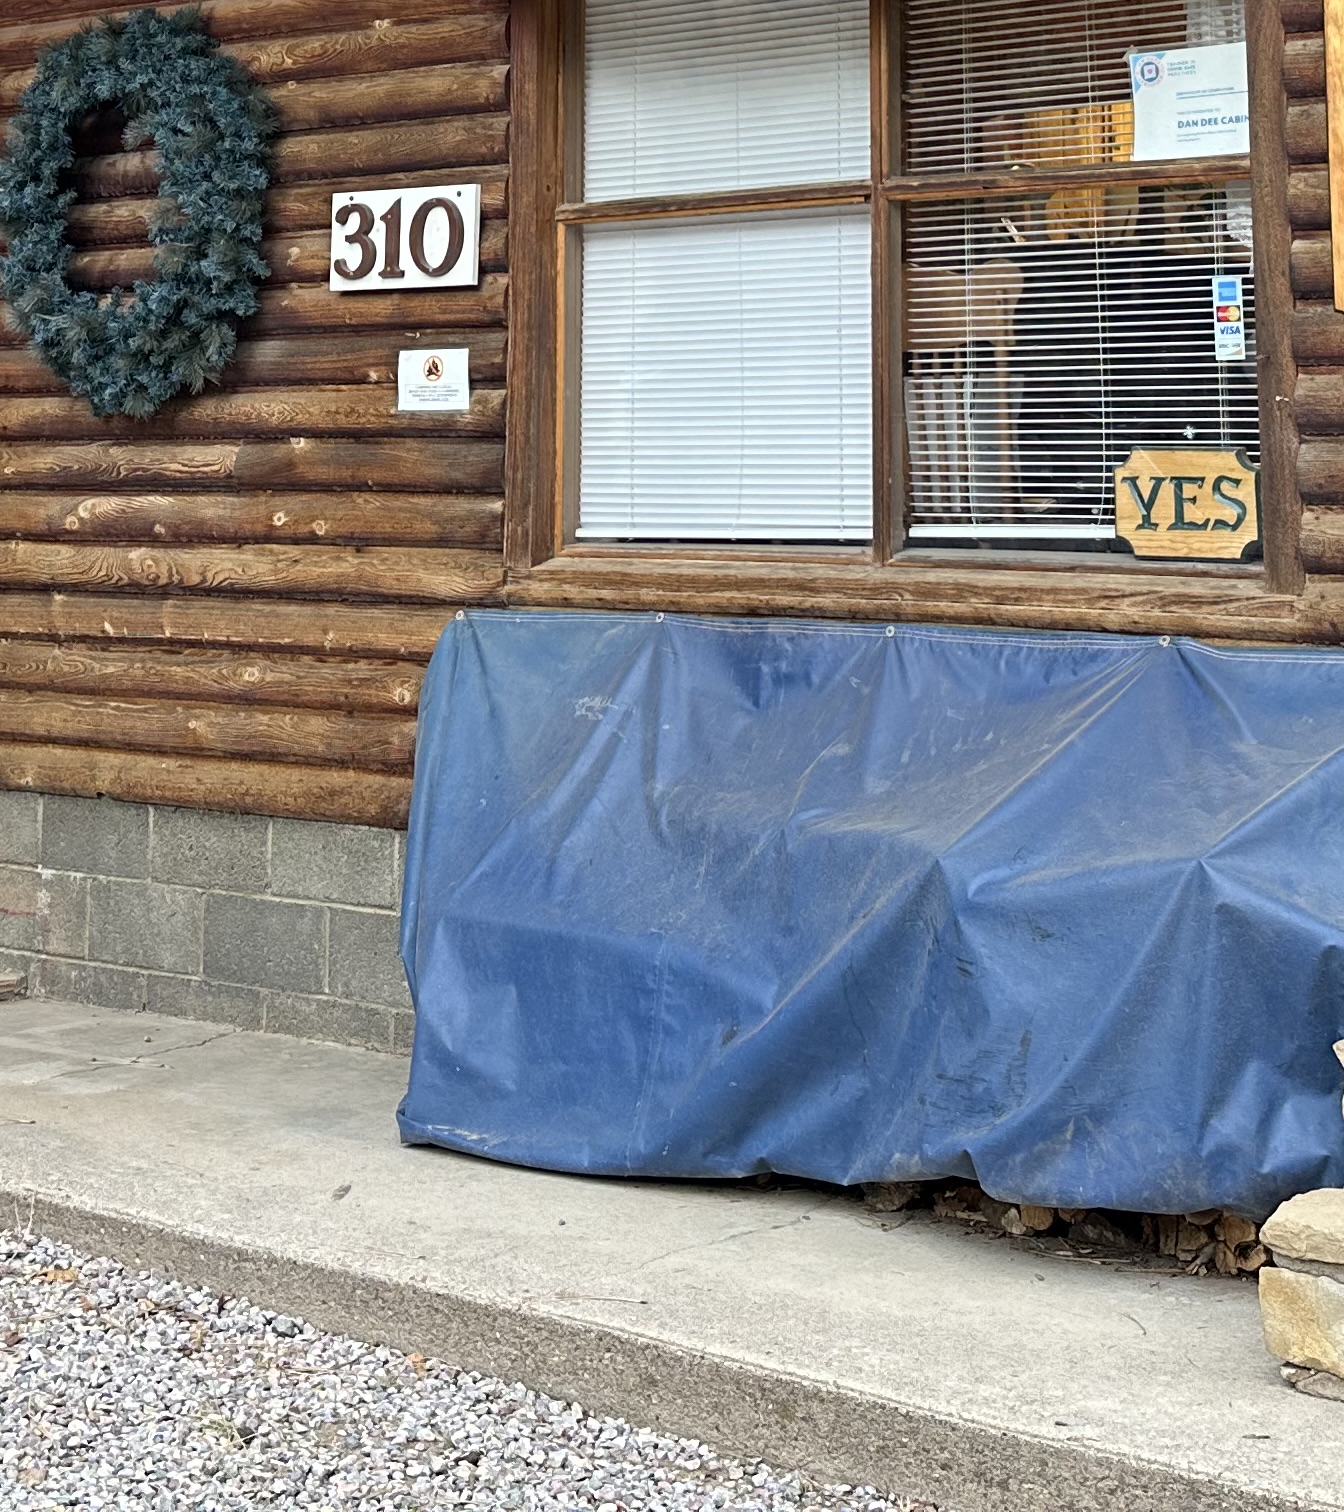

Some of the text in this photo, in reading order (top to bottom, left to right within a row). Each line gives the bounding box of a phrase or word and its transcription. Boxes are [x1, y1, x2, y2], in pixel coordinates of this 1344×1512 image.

[1177, 119, 1199, 129] DAN
[1200, 116, 1219, 127] DEE
[333, 196, 465, 281] 310
[1219, 325, 1241, 335] VISA
[1120, 474, 1248, 533] YES
